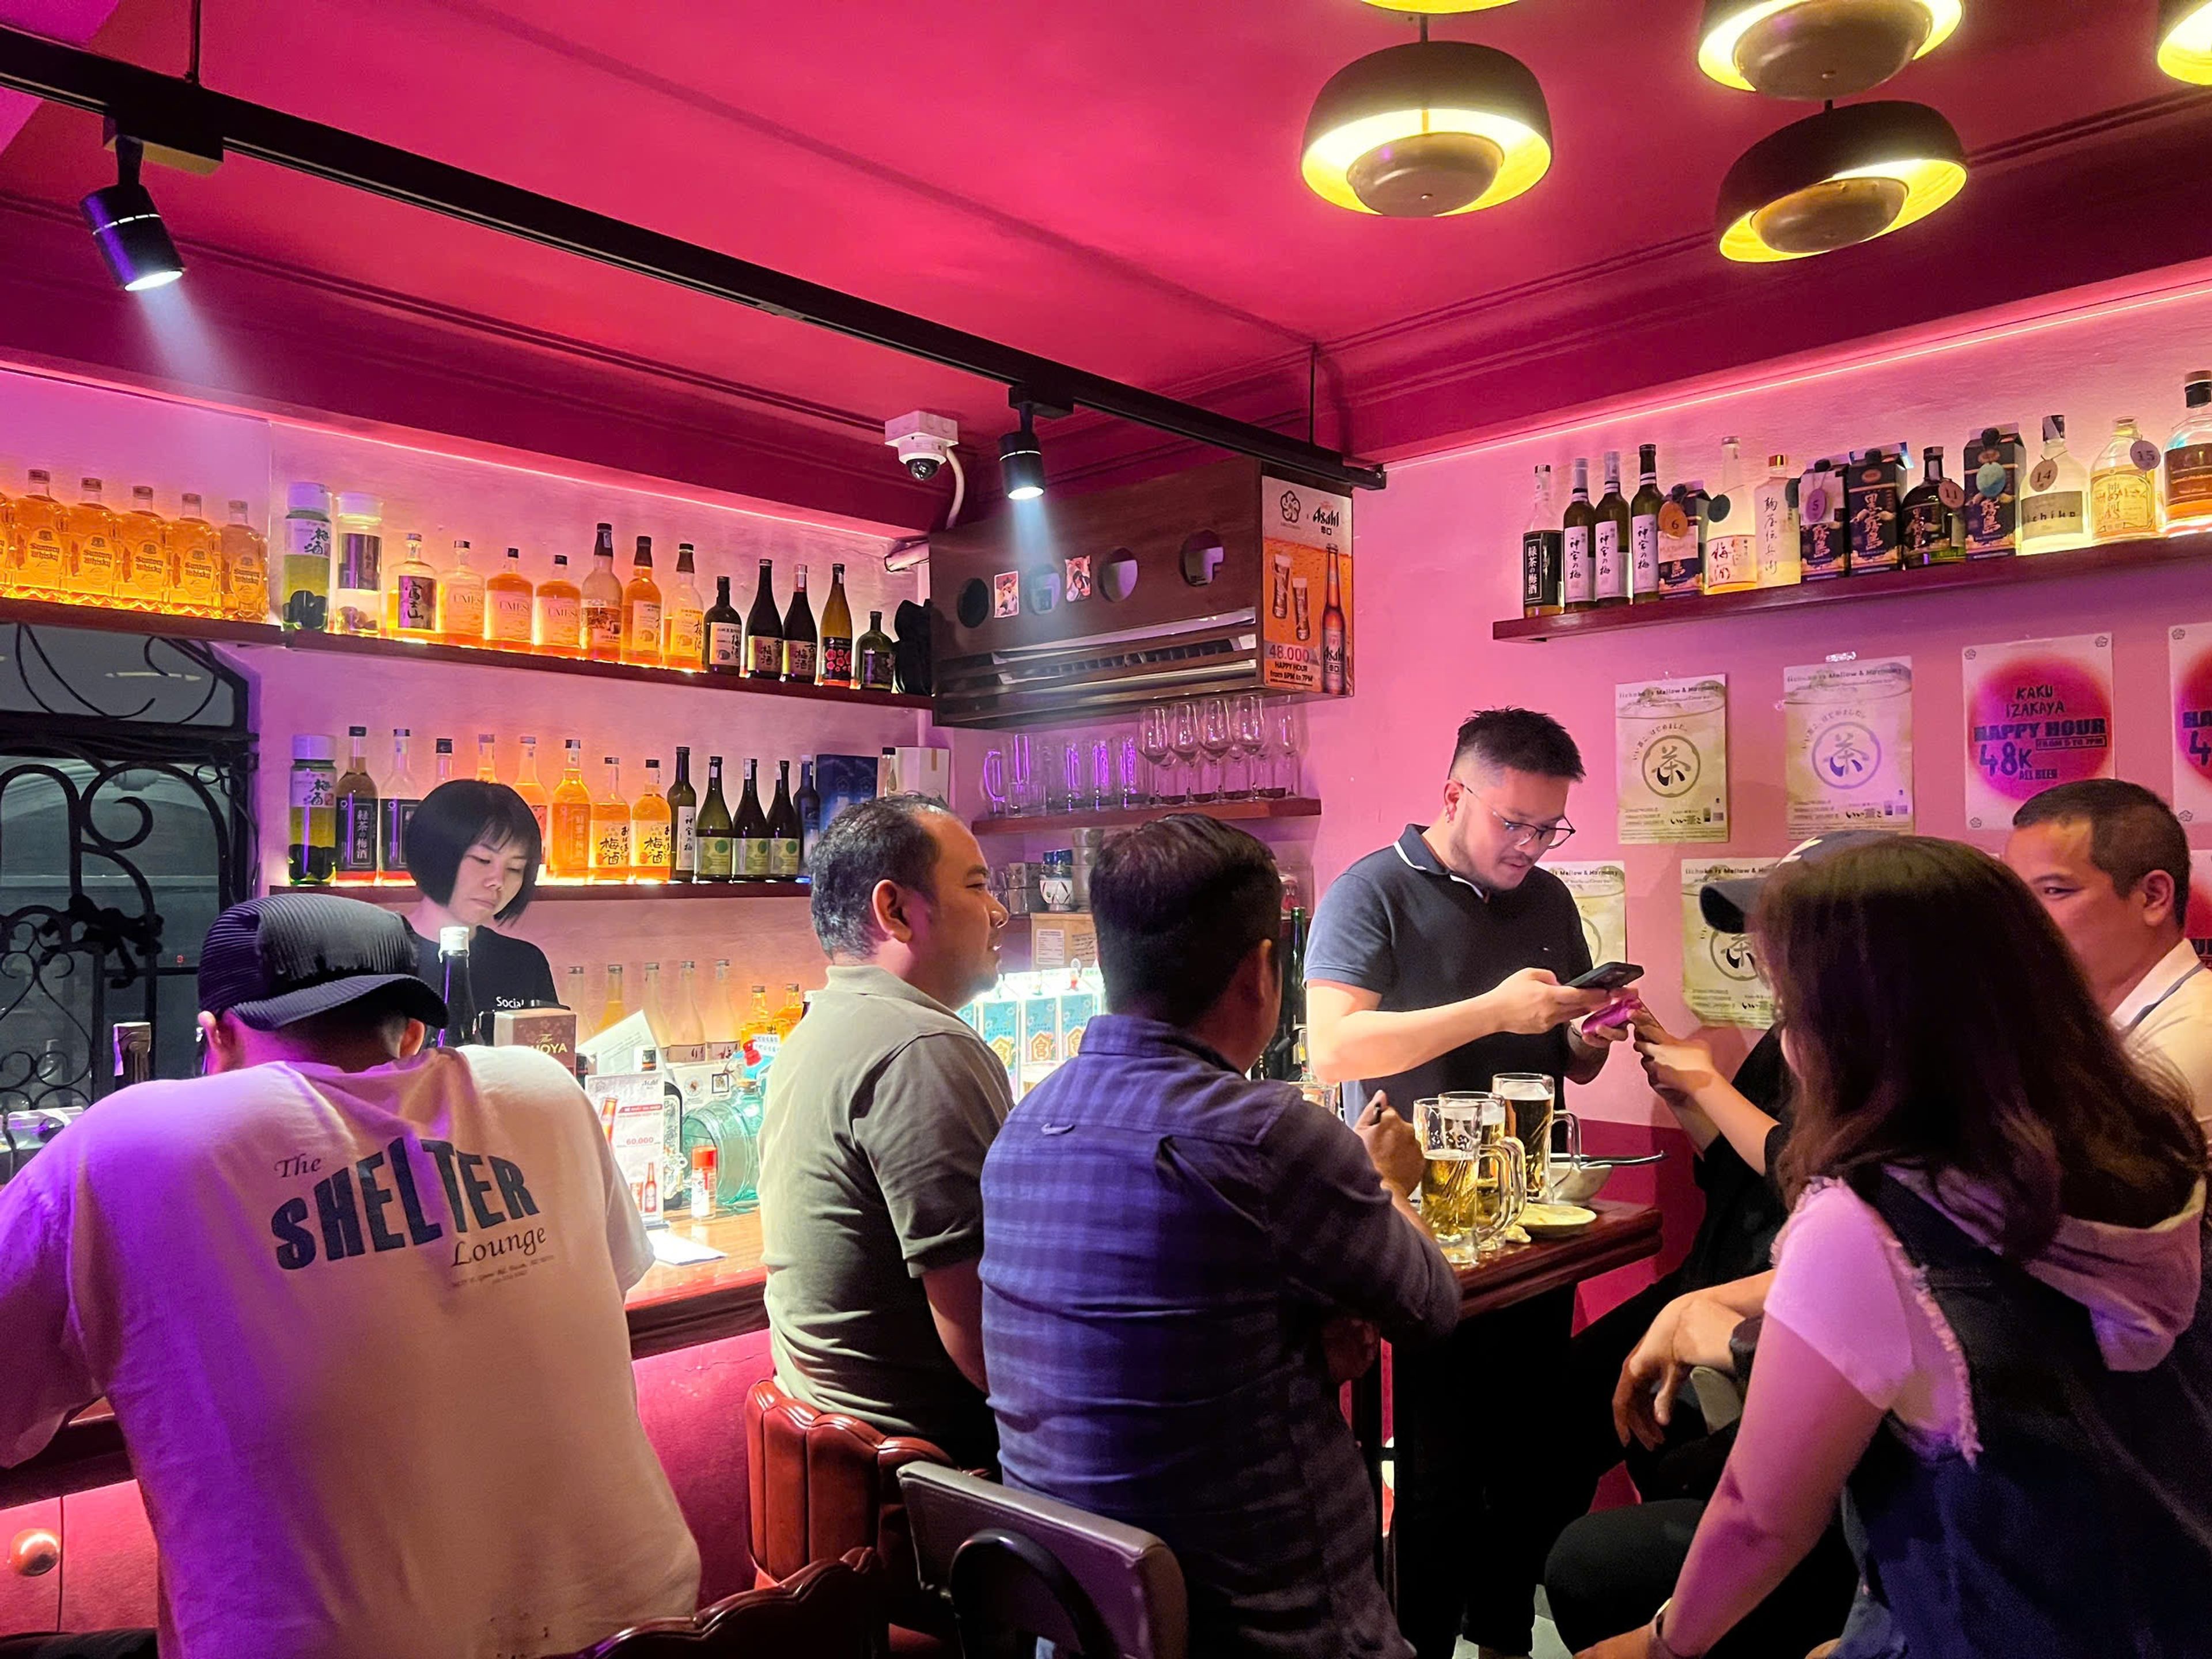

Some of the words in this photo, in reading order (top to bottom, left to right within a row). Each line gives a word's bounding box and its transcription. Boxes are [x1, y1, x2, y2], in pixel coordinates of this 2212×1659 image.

[2036, 469, 2052, 483] 14
[1812, 500, 1819, 511] 5
[1313, 506, 1340, 527] Asahi
[1671, 520, 1679, 530] 6
[304, 527, 329, 555] 梅酒
[1269, 644, 1310, 663] 48.000
[1275, 661, 1292, 669] HAPPY
[1293, 664, 1308, 672] HOUR
[2016, 685, 2053, 700] KAKU
[2006, 700, 2066, 718] IZAKAYA
[1974, 722, 2041, 742] HAPPY
[2046, 718, 2106, 737] HOUR
[600, 837, 620, 865] 梅酒
[644, 837, 663, 865] 梅酒
[529, 1043, 568, 1054] OYA
[274, 1152, 322, 1179] The
[270, 1138, 540, 1271] SHELTER
[451, 1226, 547, 1268] Lounge
